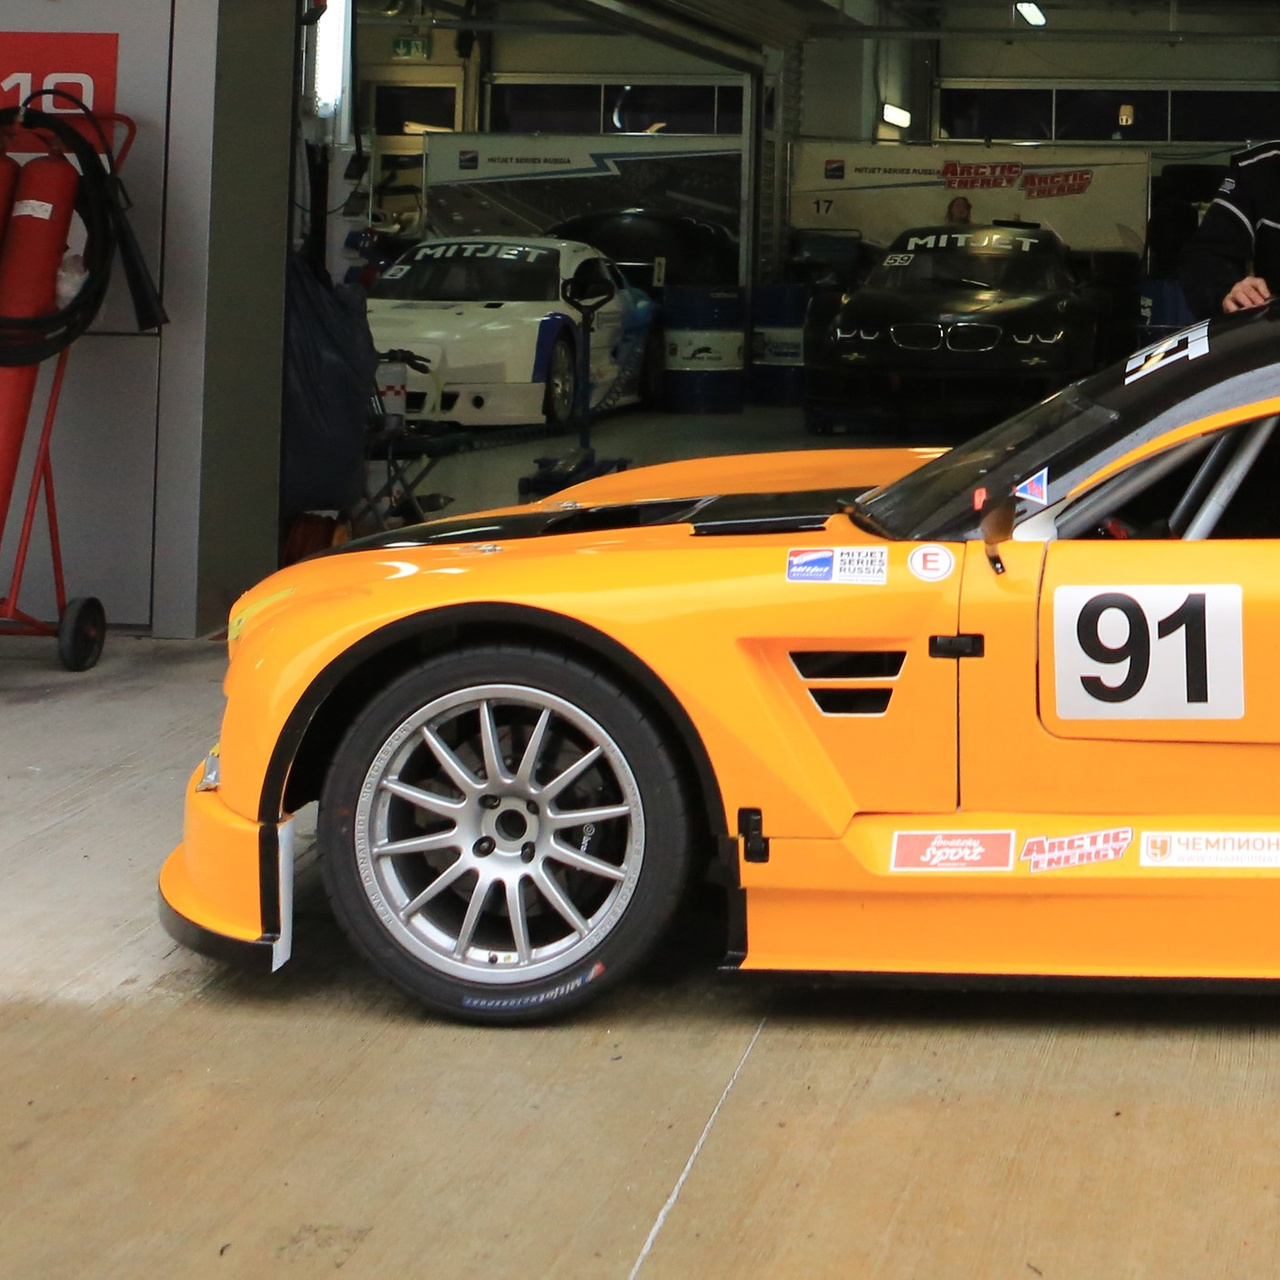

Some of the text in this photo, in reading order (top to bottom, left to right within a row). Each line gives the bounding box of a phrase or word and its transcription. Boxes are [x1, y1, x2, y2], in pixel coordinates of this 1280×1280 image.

[0, 72, 95, 114] 10
[941, 162, 1021, 177] ARCTIC
[944, 176, 1015, 189] ENERGY
[1020, 171, 1092, 189] ARCTIC
[813, 200, 833, 213] 17
[907, 233, 1039, 252] MITJET
[414, 244, 549, 263] MITJET
[885, 255, 911, 266] 59
[839, 567, 885, 575] RUSSIA
[840, 559, 886, 567] SERIES
[922, 553, 940, 571] E
[1076, 592, 1208, 704] 91
[1021, 828, 1132, 858] ARCTIC
[1031, 844, 1126, 871] ENERGY
